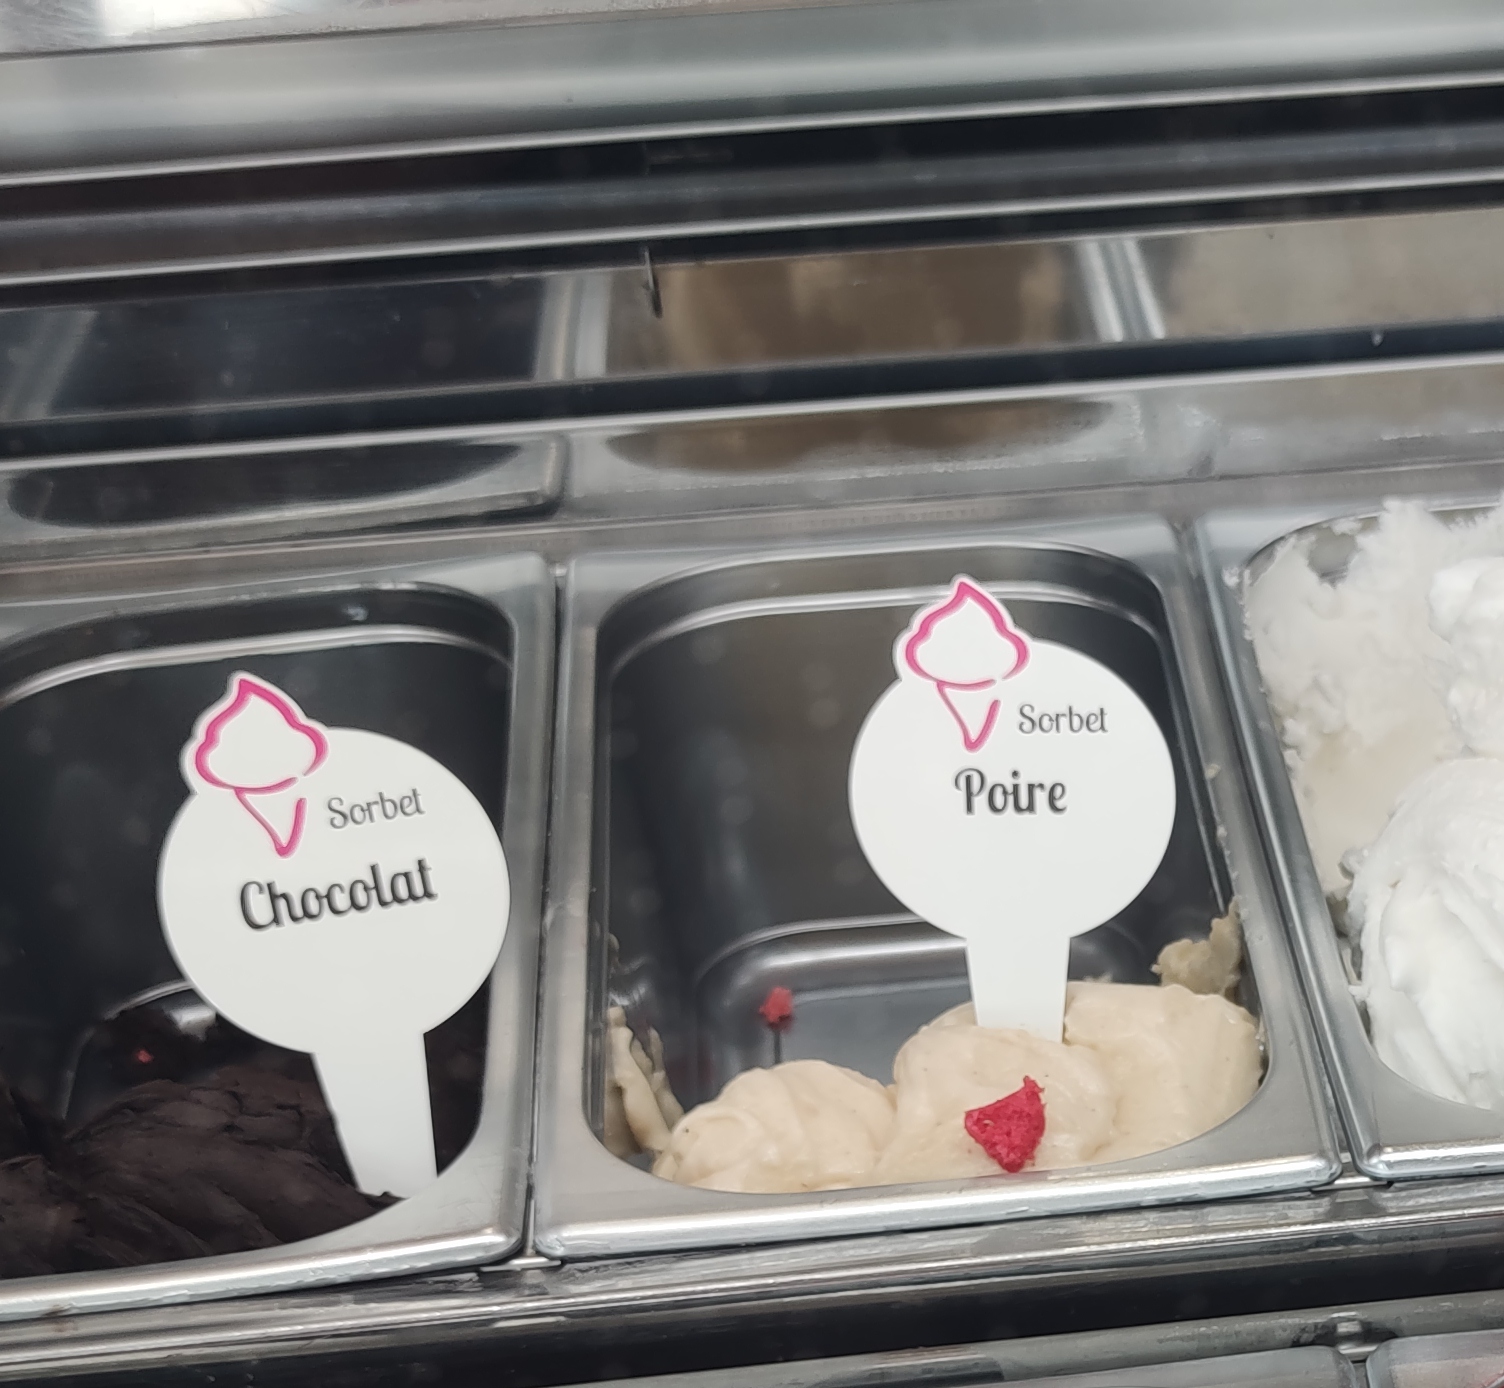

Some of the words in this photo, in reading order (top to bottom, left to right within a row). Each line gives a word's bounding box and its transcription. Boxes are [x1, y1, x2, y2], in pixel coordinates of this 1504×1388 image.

[1018, 704, 1108, 734] Sorbet
[327, 788, 425, 829] Sorbet
[954, 767, 1067, 815] Poire
[240, 859, 438, 930] Chocolat
